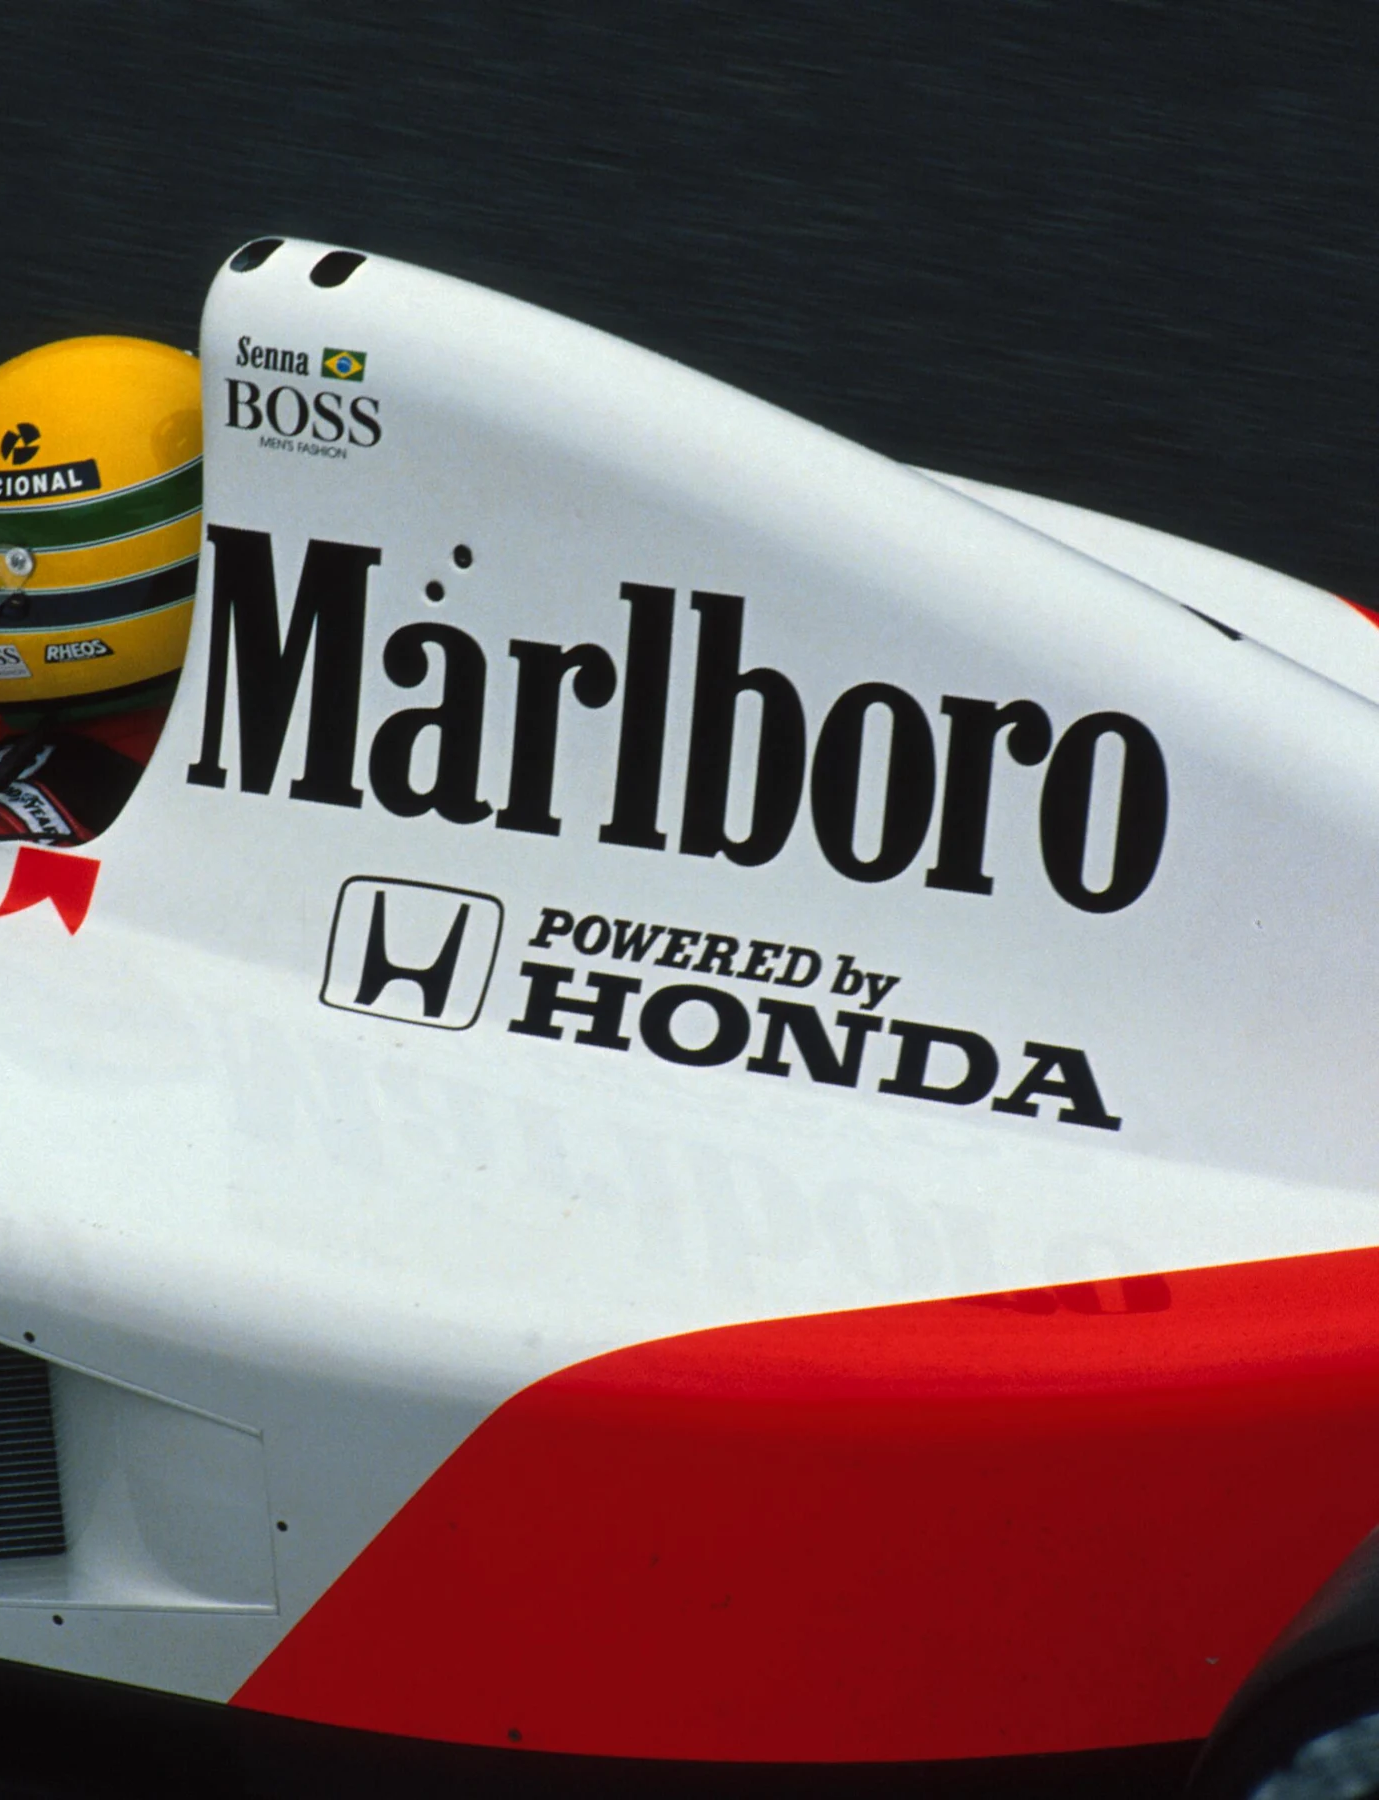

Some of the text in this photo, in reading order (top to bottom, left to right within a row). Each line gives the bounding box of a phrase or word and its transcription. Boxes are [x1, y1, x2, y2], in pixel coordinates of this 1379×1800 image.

[236, 335, 310, 376] Senna
[224, 377, 382, 448] BOSS
[297, 442, 348, 459] FASHION
[46, 639, 108, 661] RHEOS
[187, 523, 1169, 914] Marlboro
[528, 908, 902, 1011] POWERED by
[507, 961, 1123, 1132] HONDA
